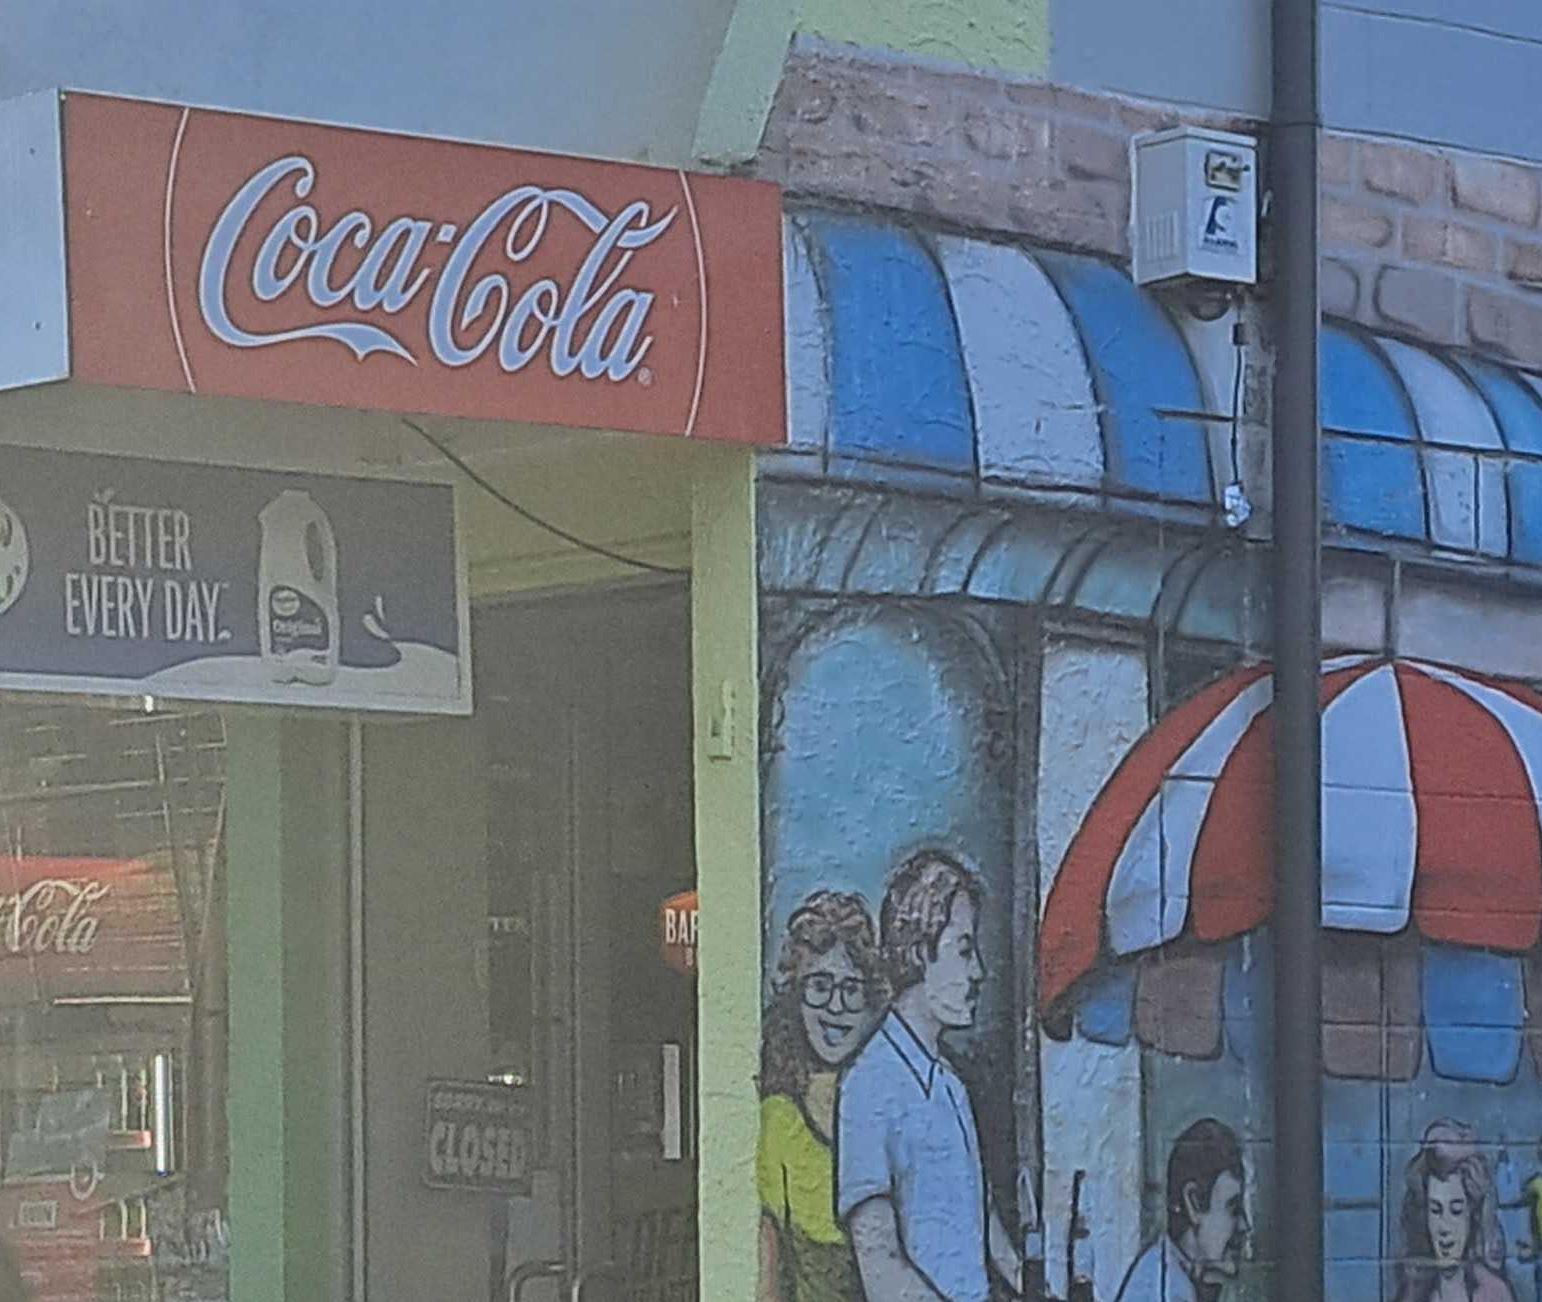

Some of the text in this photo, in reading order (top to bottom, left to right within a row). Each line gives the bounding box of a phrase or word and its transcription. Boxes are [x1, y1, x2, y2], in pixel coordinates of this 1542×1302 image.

[197, 156, 678, 383] Coca-Cola
[87, 503, 193, 572] BETTER
[64, 571, 154, 641] EVERY
